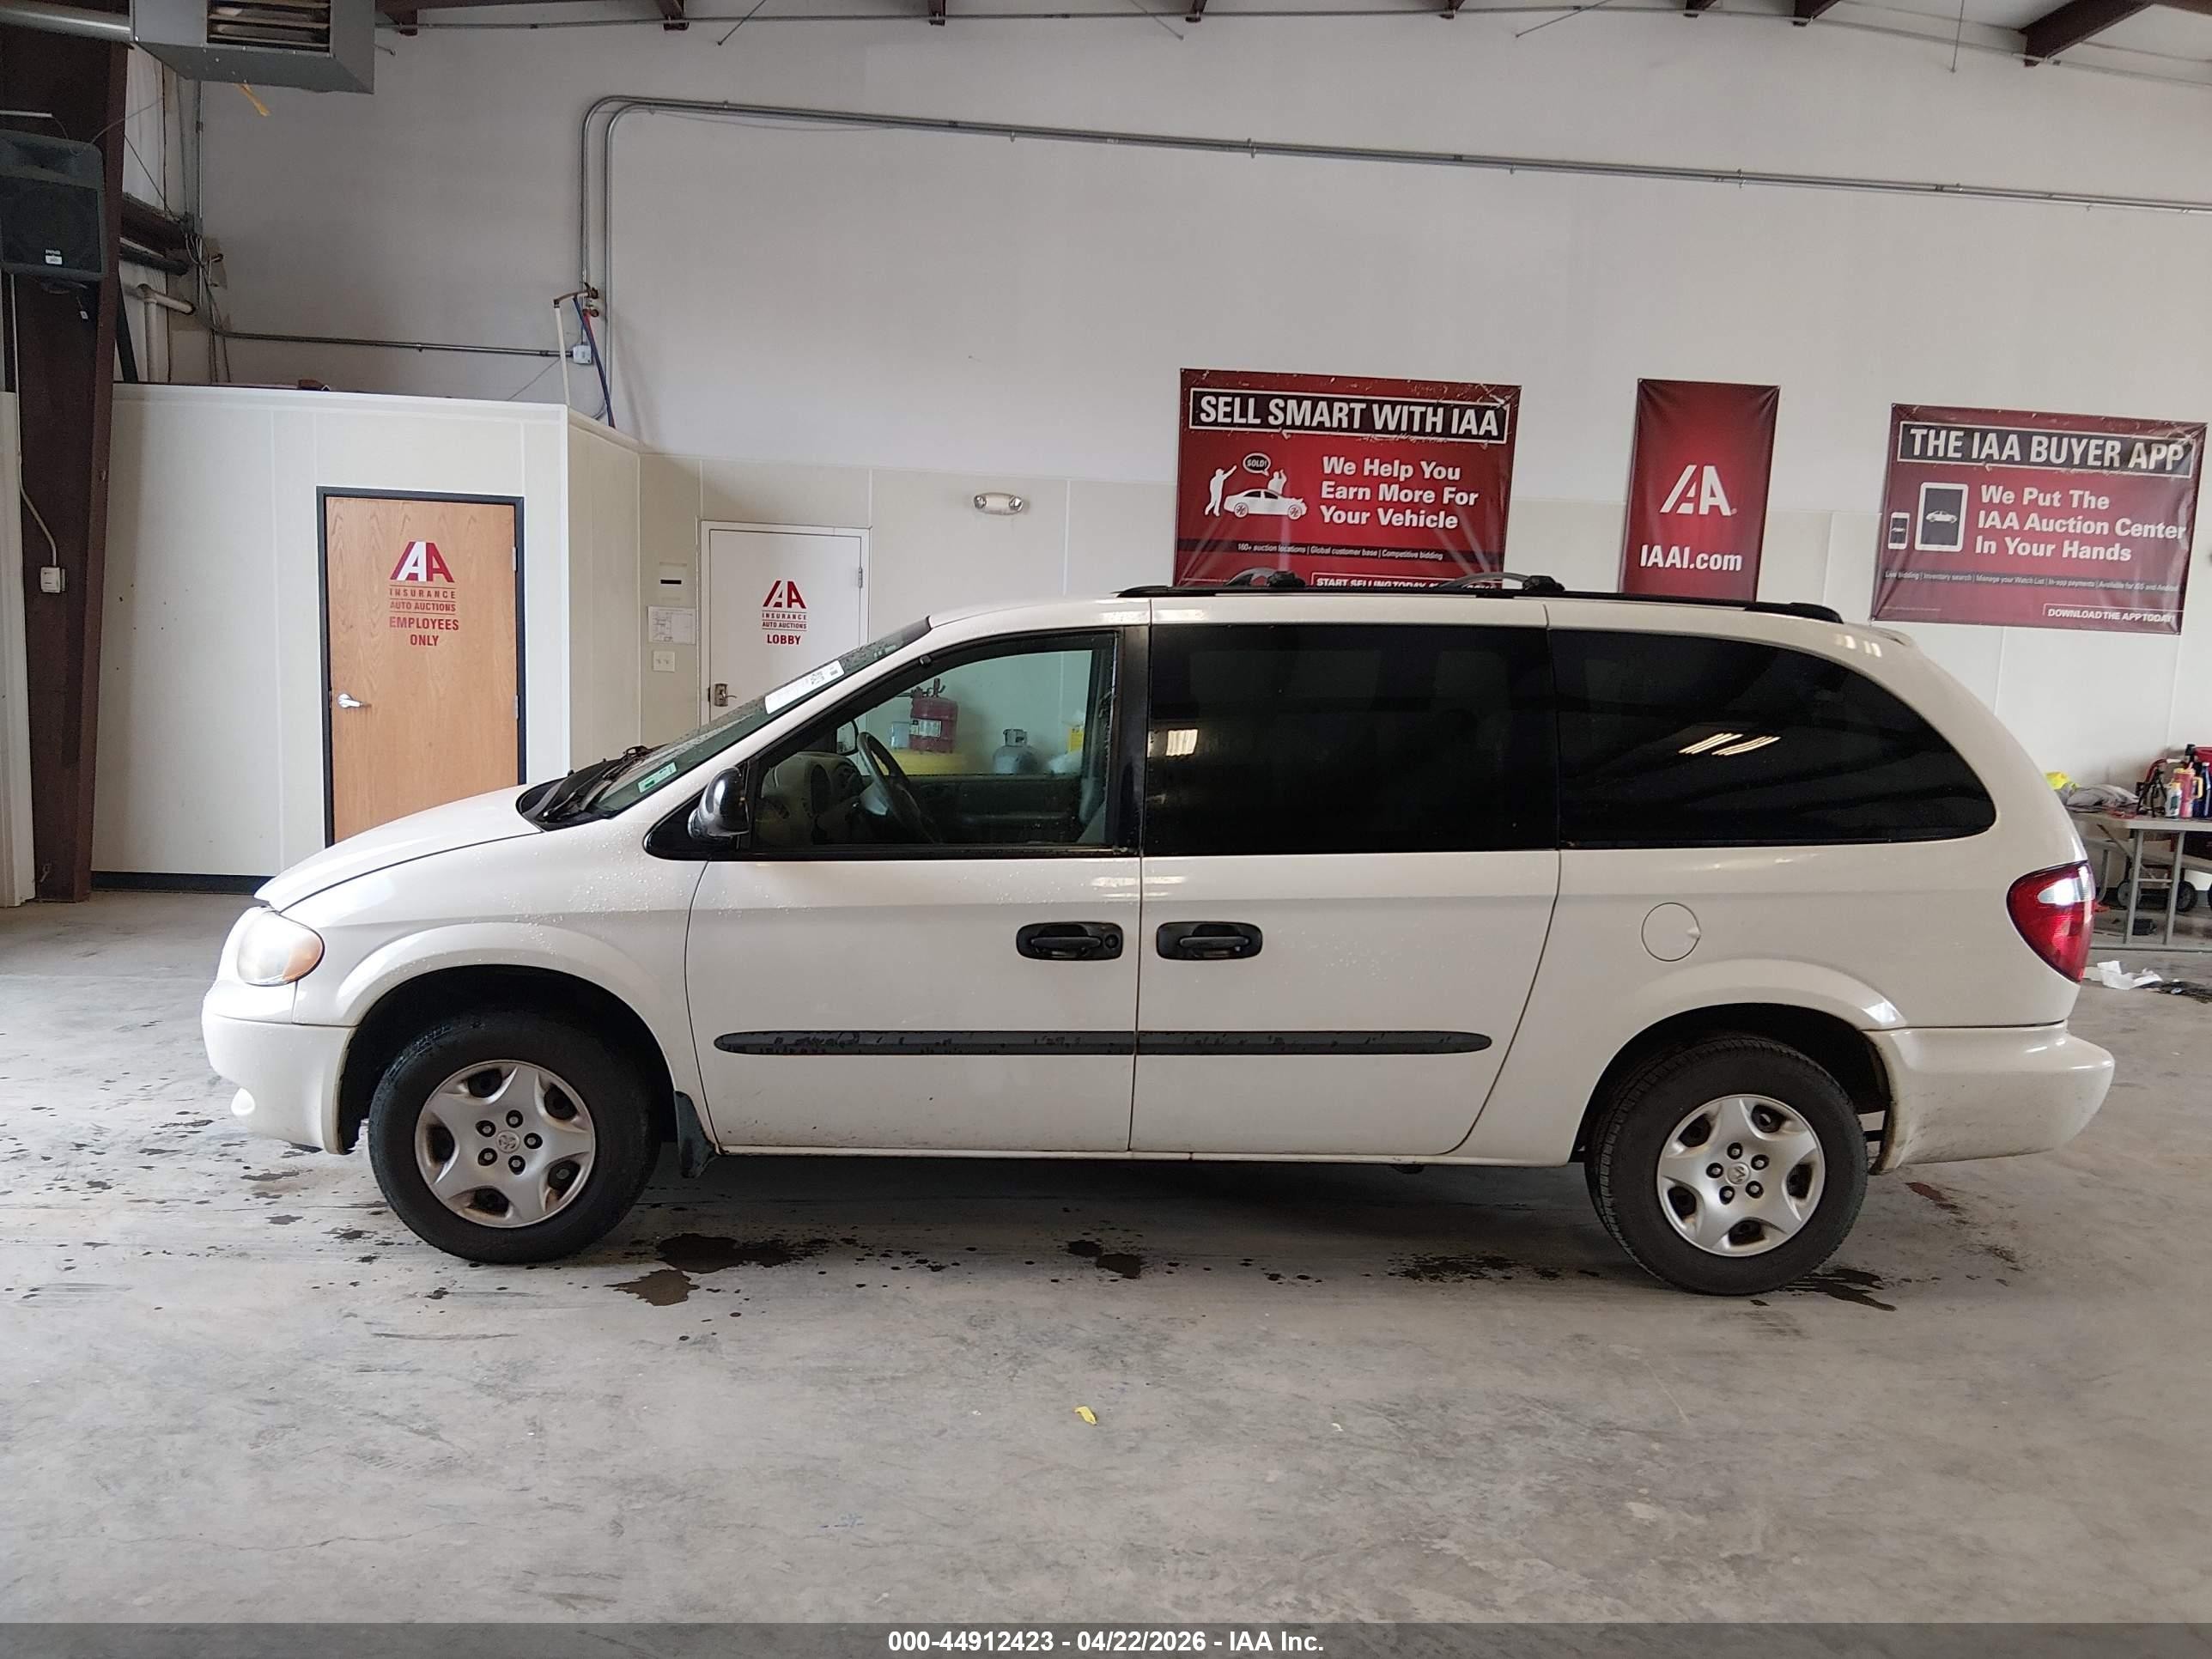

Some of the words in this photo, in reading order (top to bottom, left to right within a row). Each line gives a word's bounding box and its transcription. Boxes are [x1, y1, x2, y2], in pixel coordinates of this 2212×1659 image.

[1200, 396, 1261, 424] SELL
[1267, 398, 1366, 428] SMART
[1372, 404, 1443, 434] WITH
[1450, 407, 1498, 436] IAA
[1910, 428, 1964, 458] THE
[1972, 432, 2021, 462] IAA
[2030, 437, 2120, 467] BUYER
[2129, 442, 2185, 471] APP
[1247, 458, 1267, 468] SOLD!
[1322, 457, 1356, 476] We
[1364, 459, 1414, 482] Help
[1419, 461, 1462, 481] You
[1321, 481, 1371, 501] Earn
[1378, 483, 1436, 504] More
[1442, 487, 1479, 507] For
[1981, 484, 2014, 504] We
[2022, 487, 2062, 507] Put
[2069, 489, 2110, 509] The
[1320, 506, 1370, 526] Your
[1377, 508, 1458, 529] Vehicle
[1978, 510, 2019, 530] IAA
[2024, 515, 2109, 536] Auction
[2116, 518, 2186, 540] Center
[1310, 546, 1331, 556] Global
[1332, 548, 1361, 556] customer
[1639, 544, 1743, 571] IAAI.com
[1975, 536, 1996, 555] In
[2004, 537, 2056, 558] Your
[2062, 541, 2132, 562] Hands
[1316, 578, 1347, 587] START
[389, 587, 456, 599] INSURANCE
[390, 601, 412, 610] AUTO
[414, 603, 456, 612] AUCTIONS
[2048, 608, 2104, 619] DOWNLOAD
[2104, 611, 2121, 620] THE
[2122, 612, 2142, 622] APP
[389, 617, 459, 630] EMPLOYEES
[410, 634, 440, 647] ONLY
[767, 634, 801, 645] LOBBY
